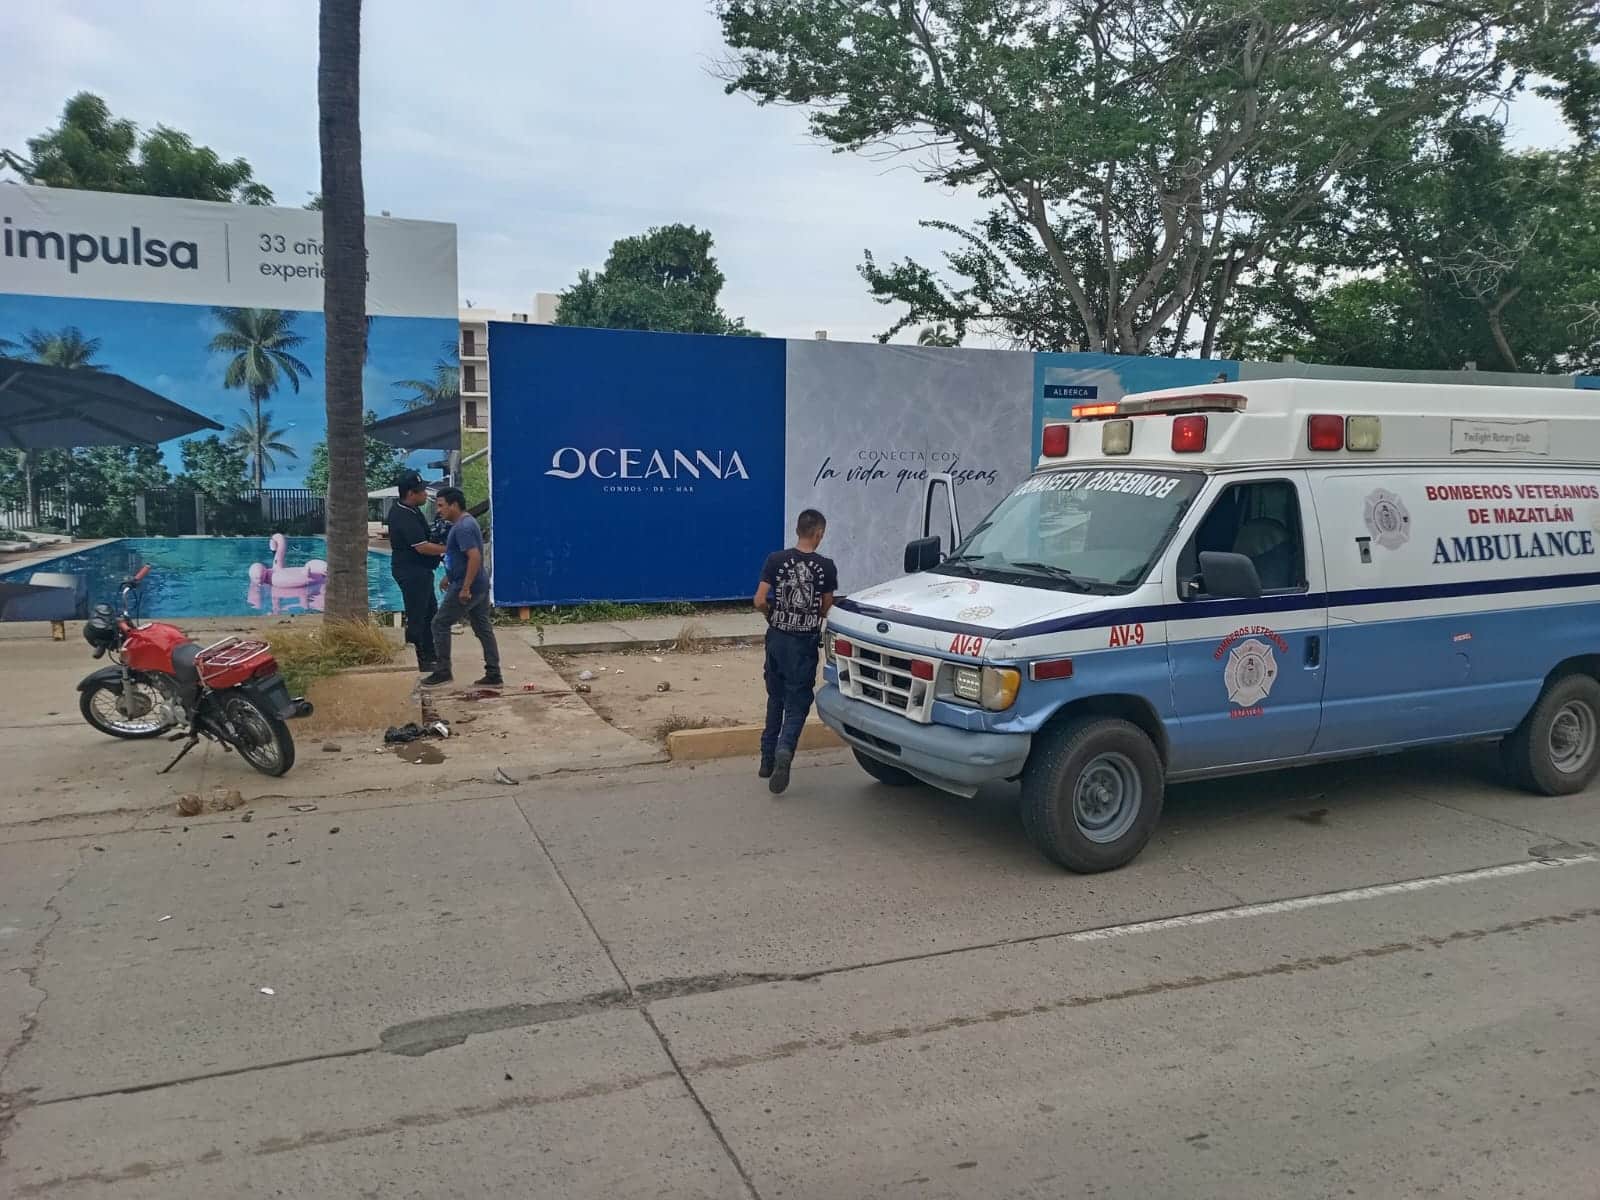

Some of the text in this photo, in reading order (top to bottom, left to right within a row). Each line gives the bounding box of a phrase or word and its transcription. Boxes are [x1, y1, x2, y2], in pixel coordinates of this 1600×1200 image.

[4, 216, 199, 274] impulsa
[260, 234, 328, 256] 33 año
[1053, 388, 1089, 396] ALBERCA
[544, 447, 749, 479] OCEANNA
[858, 450, 960, 461] CONECTA CON
[813, 457, 841, 487] la
[847, 459, 890, 486] vida
[896, 466, 929, 494] que
[1425, 485, 1599, 501] BOMBEROS VETERANOS
[1469, 504, 1574, 524] DE MAZATLÁN
[1432, 530, 1595, 564] AMBULANCE
[950, 634, 983, 657] AV-9
[1109, 624, 1144, 647] AV-9
